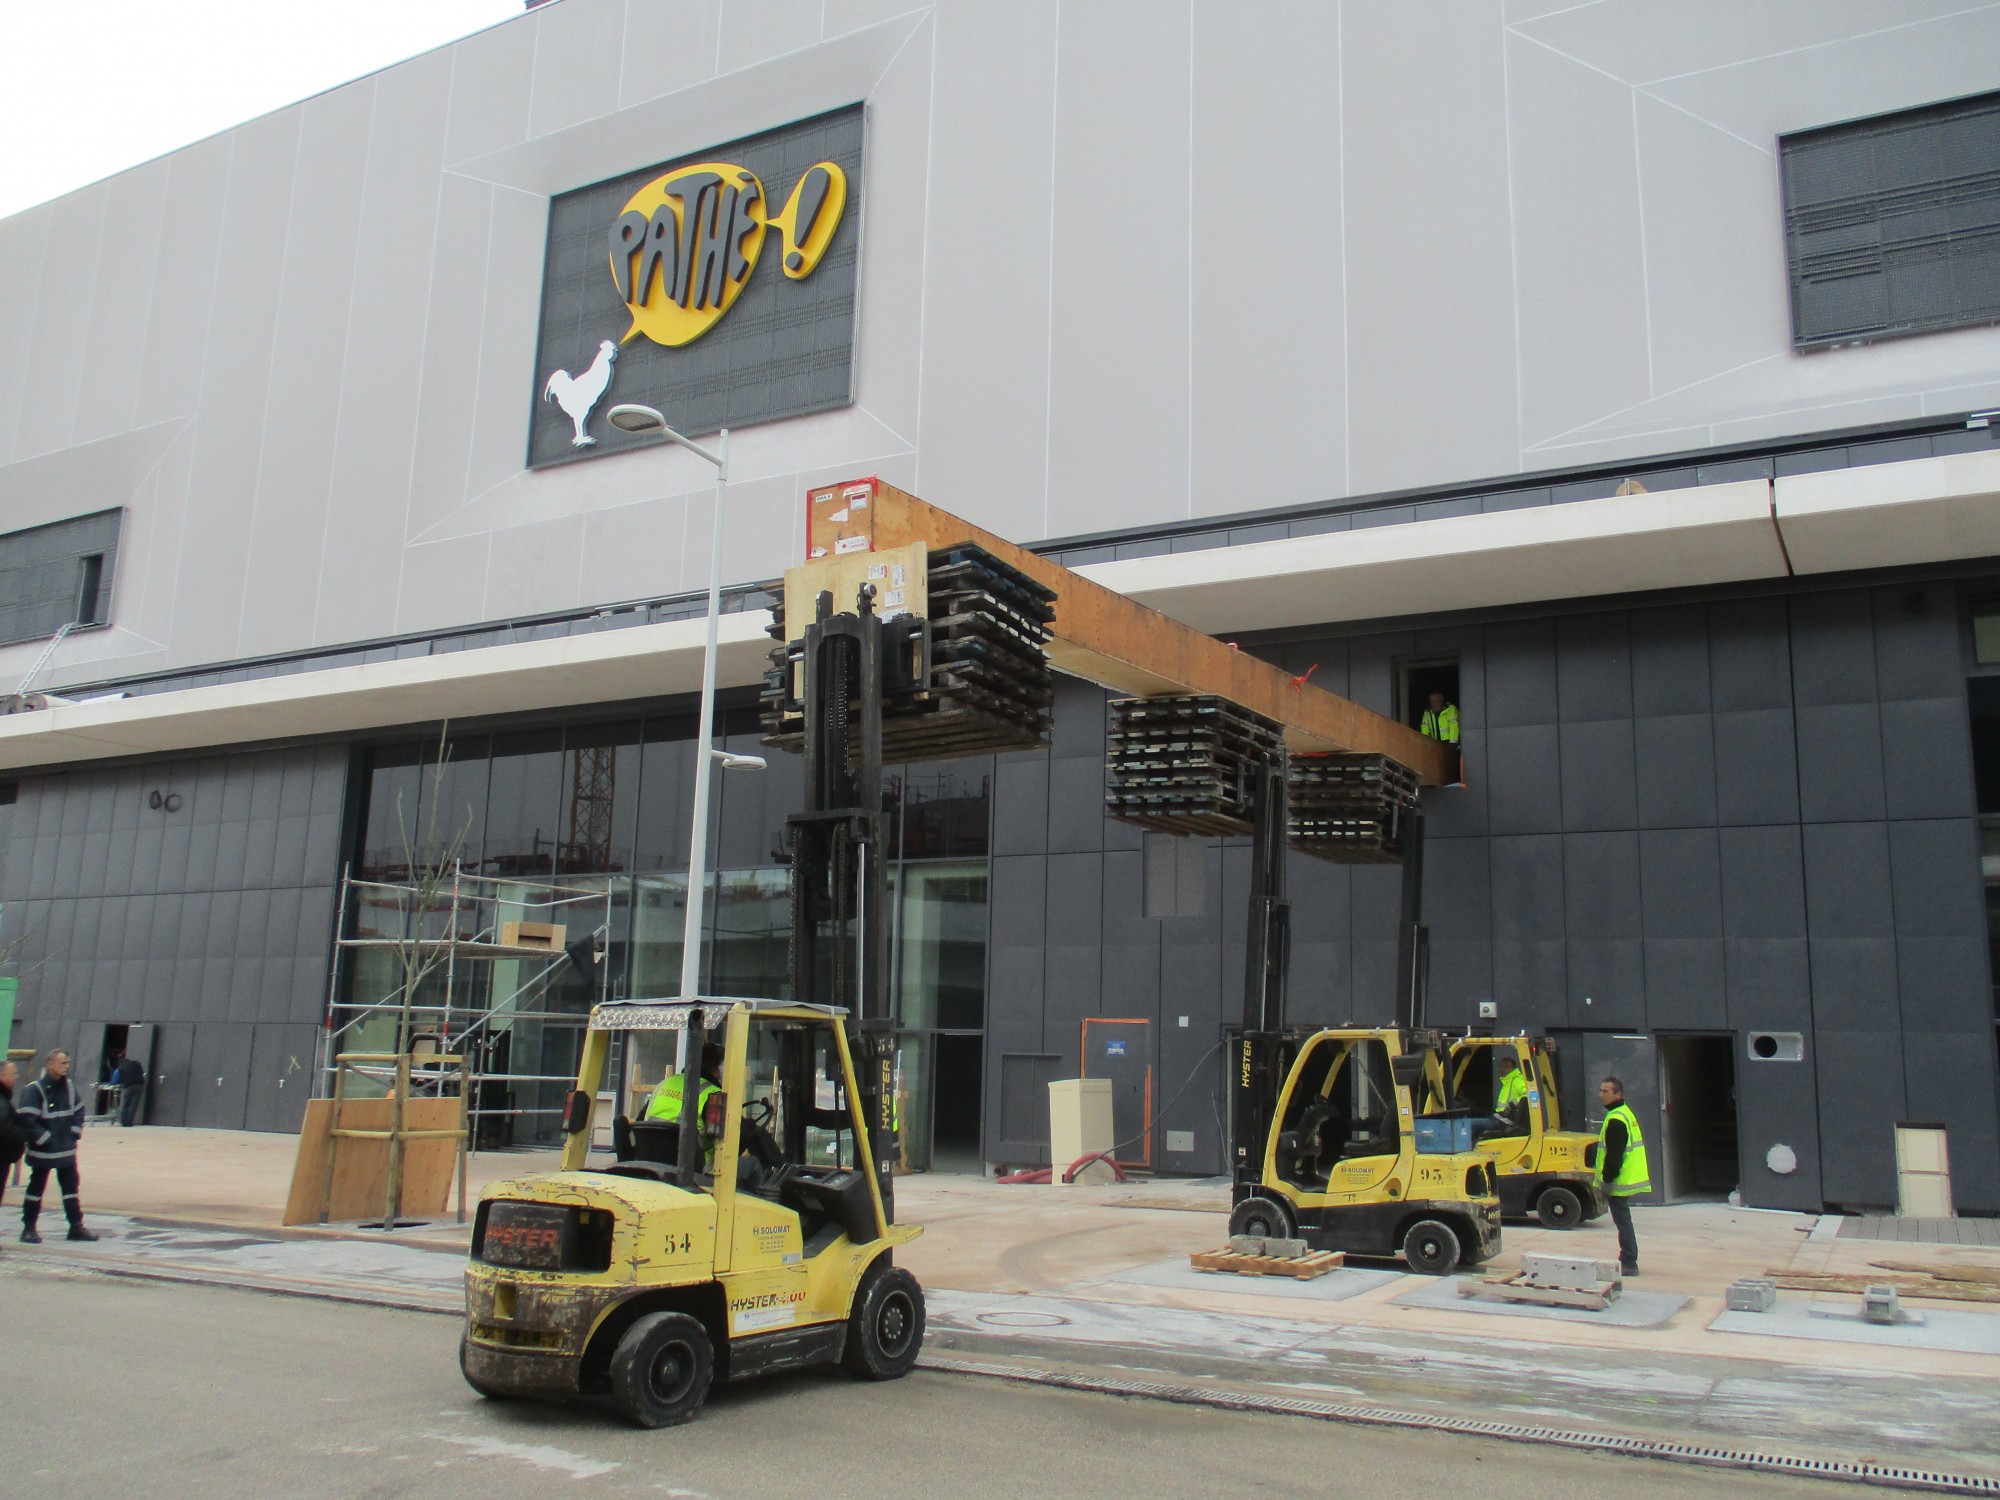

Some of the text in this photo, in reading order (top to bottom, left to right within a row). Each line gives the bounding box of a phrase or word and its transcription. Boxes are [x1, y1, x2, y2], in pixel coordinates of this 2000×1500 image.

[1241, 1040, 1252, 1088] HYSTER
[881, 1059, 891, 1131] HYSTER
[760, 1225, 790, 1235] SOLOMAT
[664, 1232, 692, 1256] 54
[730, 1294, 777, 1311] HYSTER
